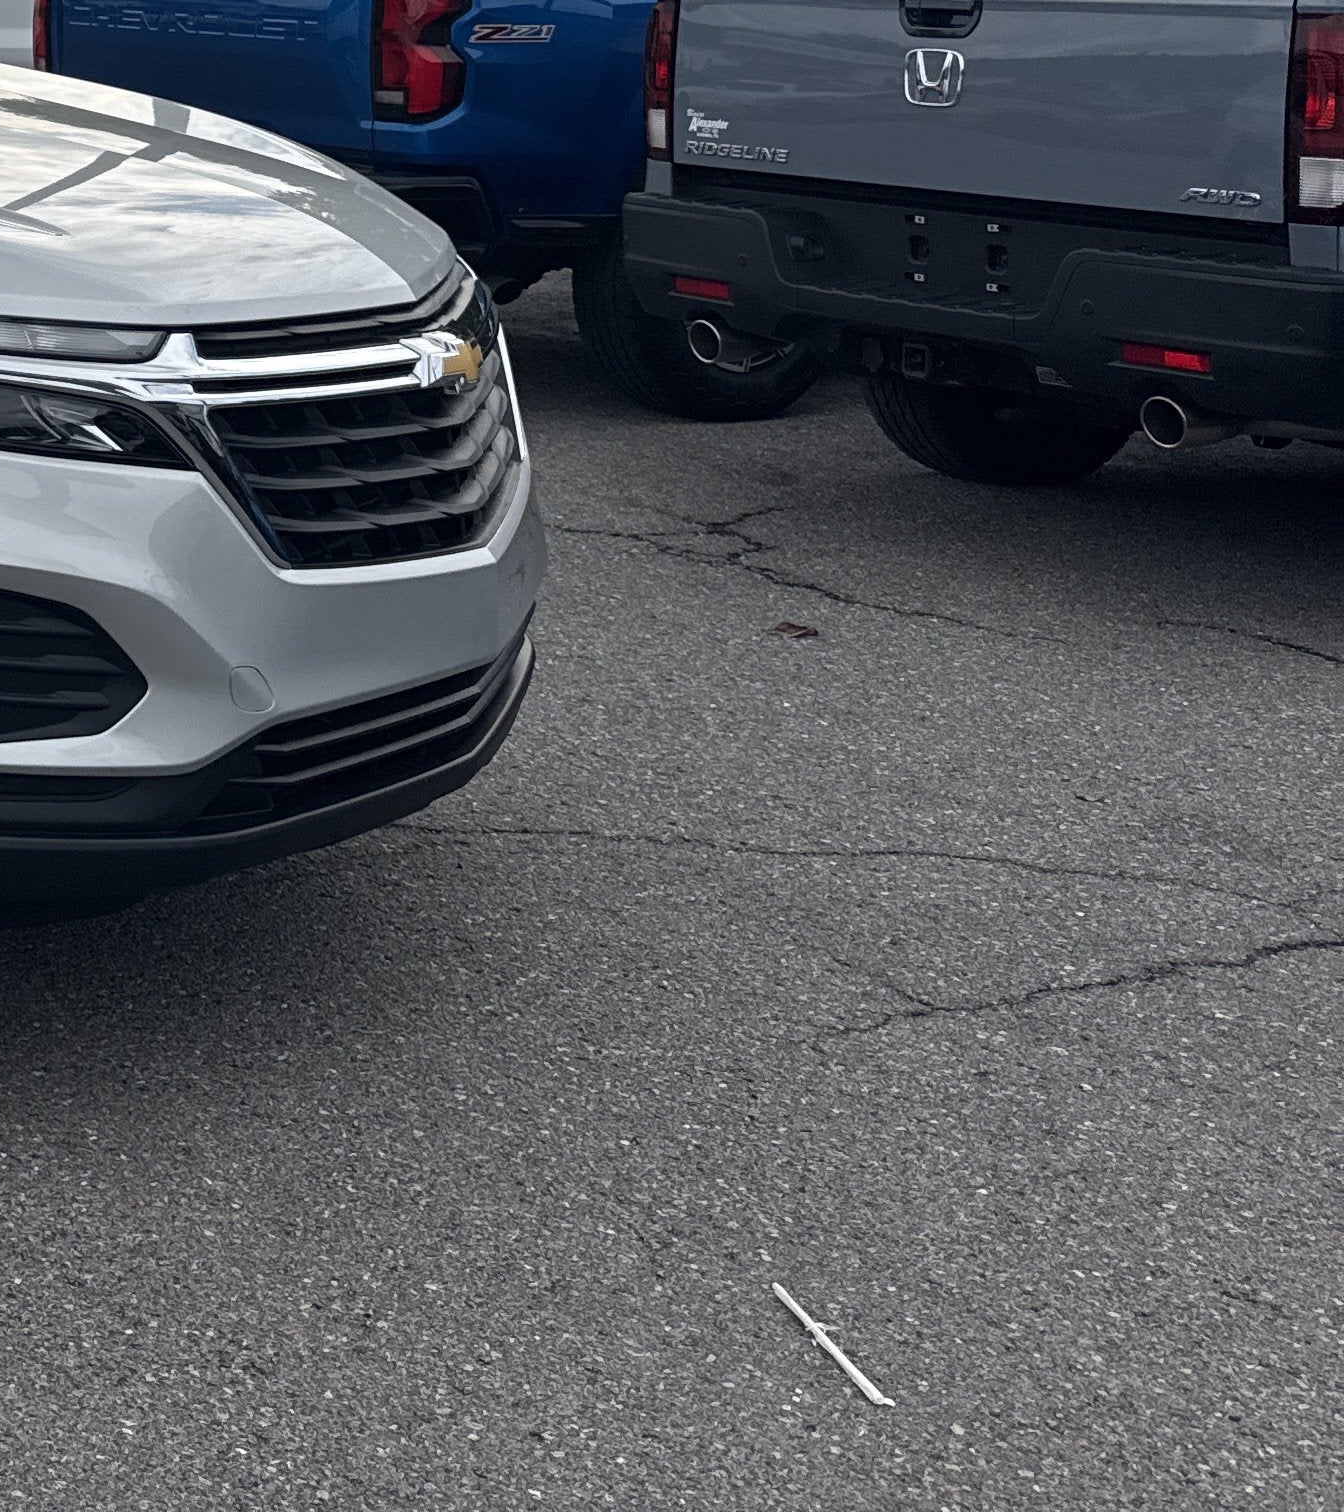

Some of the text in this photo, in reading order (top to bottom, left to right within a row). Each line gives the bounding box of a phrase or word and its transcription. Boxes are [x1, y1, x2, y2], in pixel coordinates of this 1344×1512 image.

[69, 5, 319, 42] CHEVROLET
[468, 23, 556, 43] Z71
[683, 140, 789, 163] RIDGELINE
[1179, 187, 1261, 207] AWD
